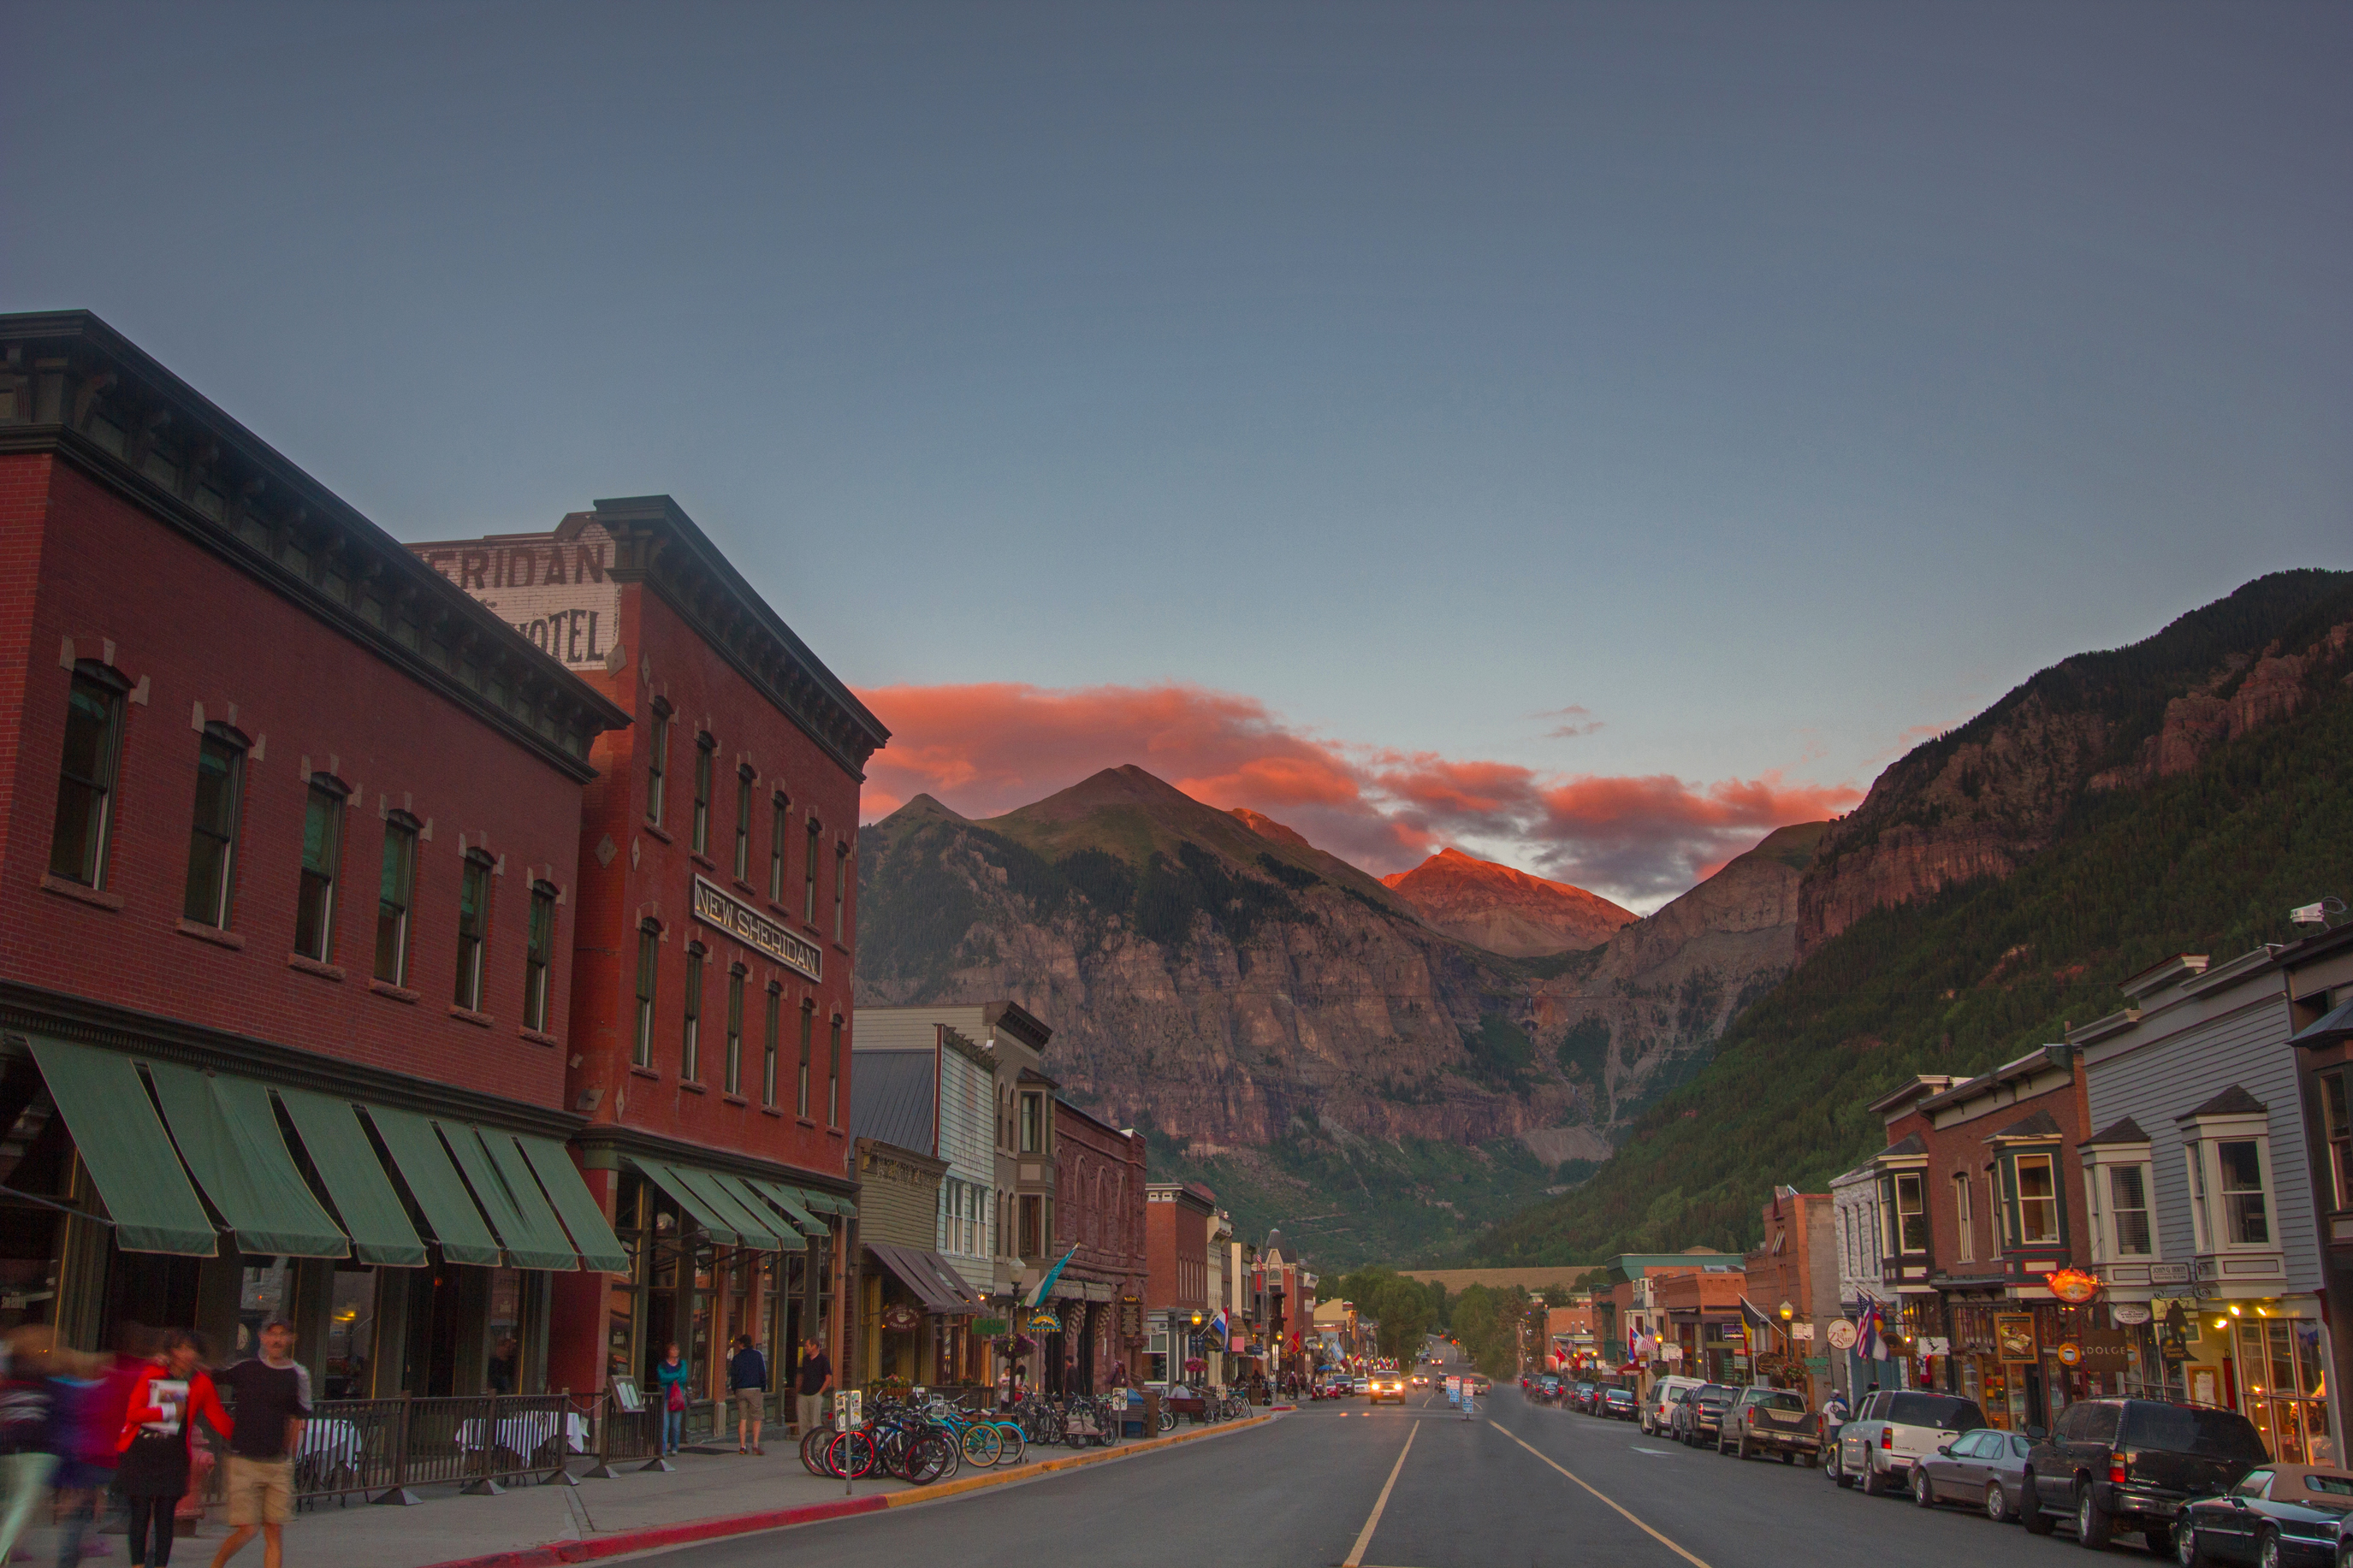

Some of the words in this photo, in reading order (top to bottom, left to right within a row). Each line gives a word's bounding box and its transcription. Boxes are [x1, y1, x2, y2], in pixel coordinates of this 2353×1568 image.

[696, 884, 734, 929] NEW
[1828, 1330, 1844, 1342] Zia
[1837, 1337, 1853, 1347] Sun
[2087, 1346, 2125, 1355] DOLCE
